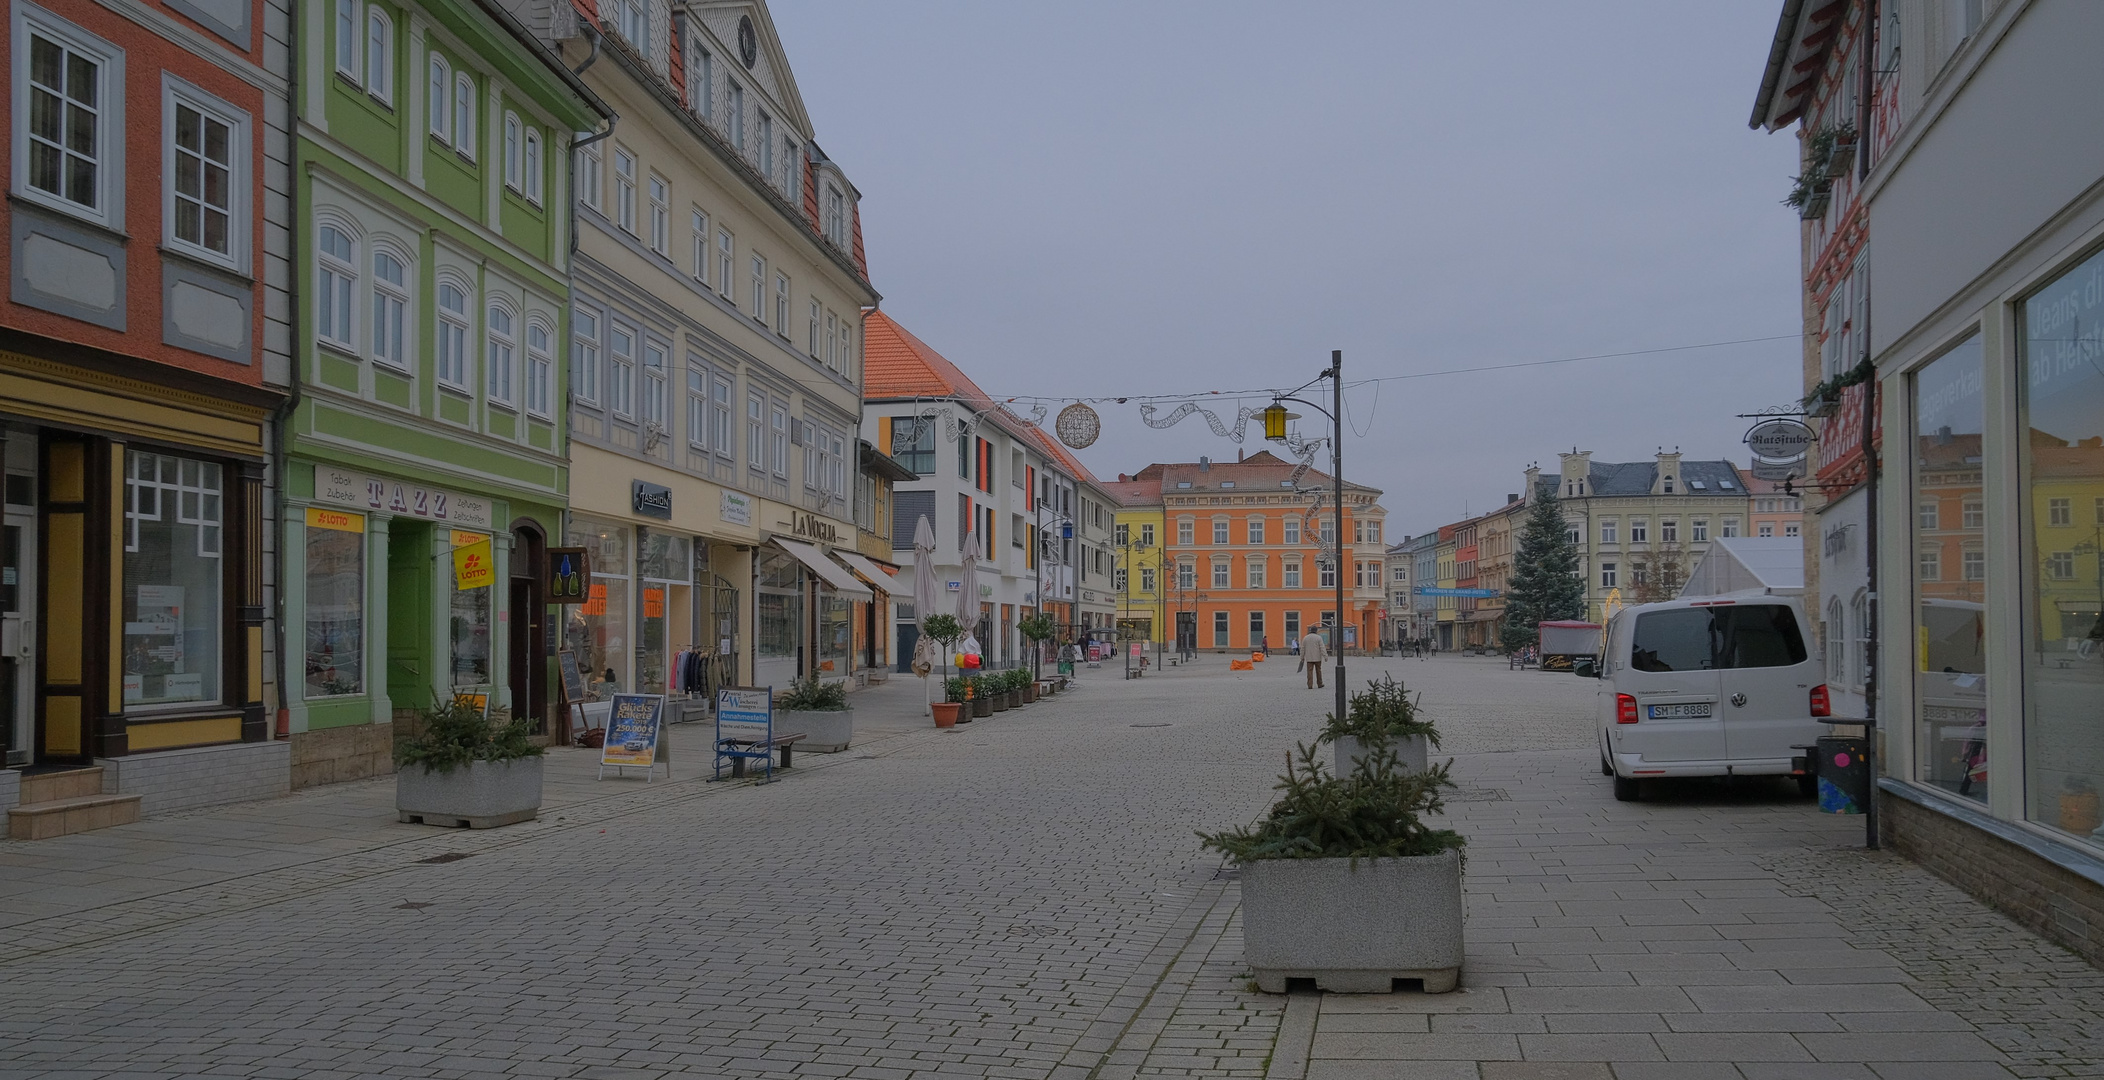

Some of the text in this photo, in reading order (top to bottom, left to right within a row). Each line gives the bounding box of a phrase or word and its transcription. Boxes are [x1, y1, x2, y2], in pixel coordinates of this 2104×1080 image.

[2032, 288, 2079, 339] Jeans
[2033, 347, 2050, 387] ab
[330, 472, 351, 486] Tabak
[326, 488, 356, 502] Zubehör
[366, 477, 447, 519] TAZZ
[457, 498, 482, 511] Zeitungen
[327, 514, 348, 526] LOTTO
[453, 511, 485, 524] Zeitschriften
[461, 568, 487, 579] LOTTO
[619, 702, 653, 712] Glücks
[1655, 705, 1709, 716] SM F 8888
[617, 710, 653, 719] Rakete
[721, 712, 767, 722] Annahmestelle
[616, 724, 655, 733] 250.000 €
